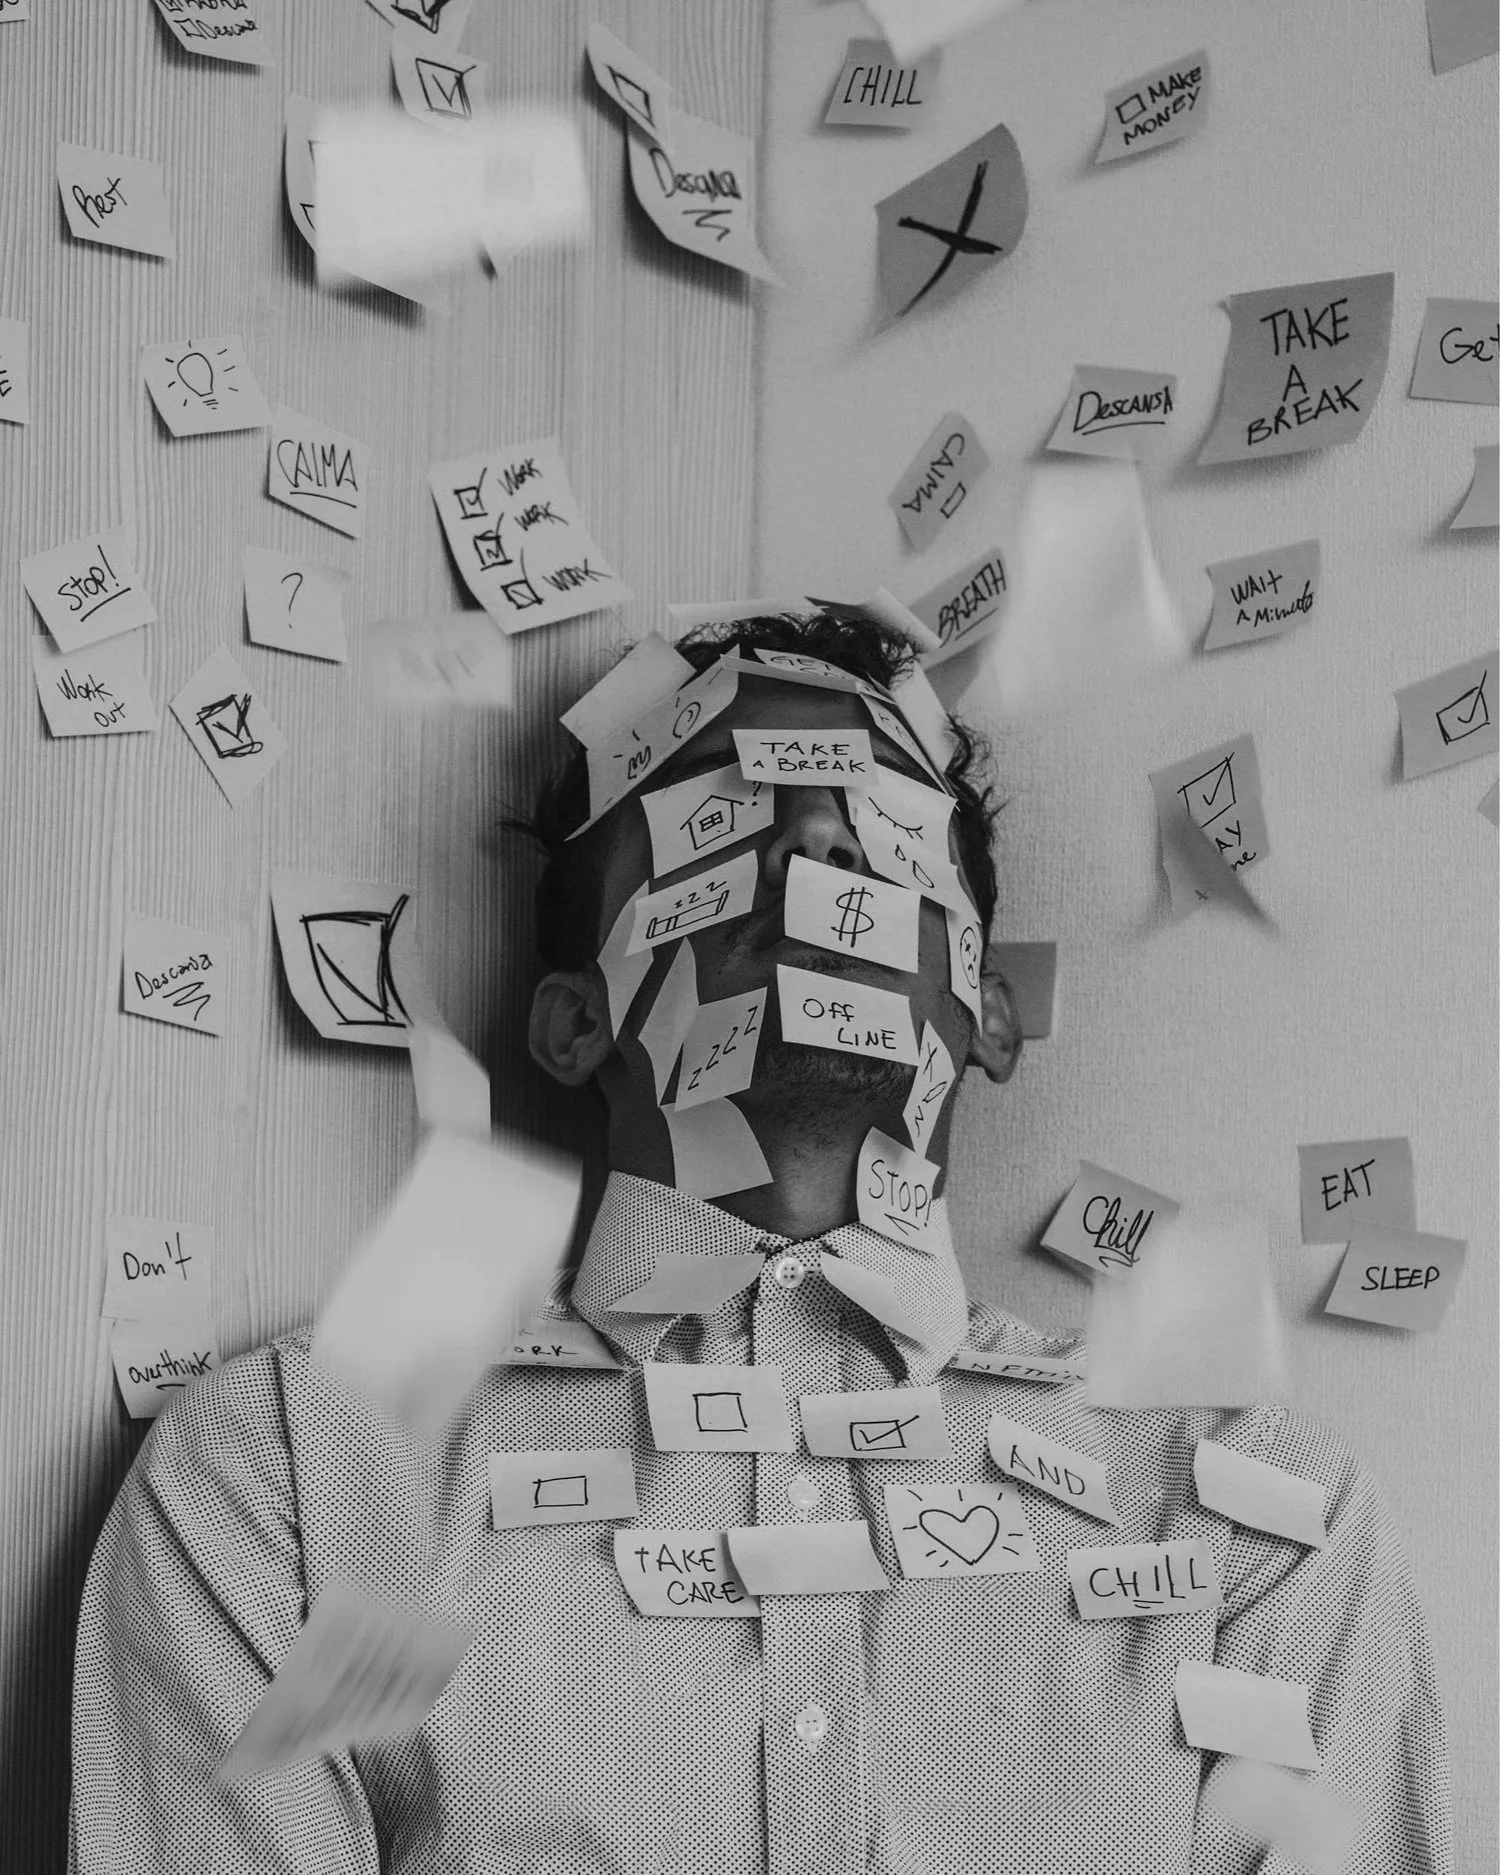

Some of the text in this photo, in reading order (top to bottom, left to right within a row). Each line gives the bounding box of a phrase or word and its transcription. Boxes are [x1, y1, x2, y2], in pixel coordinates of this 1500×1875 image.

[843, 64, 923, 108] CHILL
[1148, 66, 1202, 104] MAKE
[1124, 86, 1201, 146] MONEY
[1260, 298, 1350, 356] TAKE
[1282, 364, 1308, 402] A
[1247, 378, 1364, 446] BREAK
[938, 558, 1008, 648] BREATH
[759, 741, 850, 756] TAKE
[777, 758, 867, 773] BREAK
[830, 885, 875, 948] $
[836, 1028, 898, 1051] LINE
[1321, 1158, 1377, 1212] EAT
[1082, 1195, 1155, 1264] Chill
[123, 1231, 193, 1281] Don't
[1360, 1265, 1441, 1291] SLEEP
[1009, 1444, 1087, 1497] AND
[666, 1579, 745, 1606] CARE
[1088, 1554, 1208, 1601] CHILL
